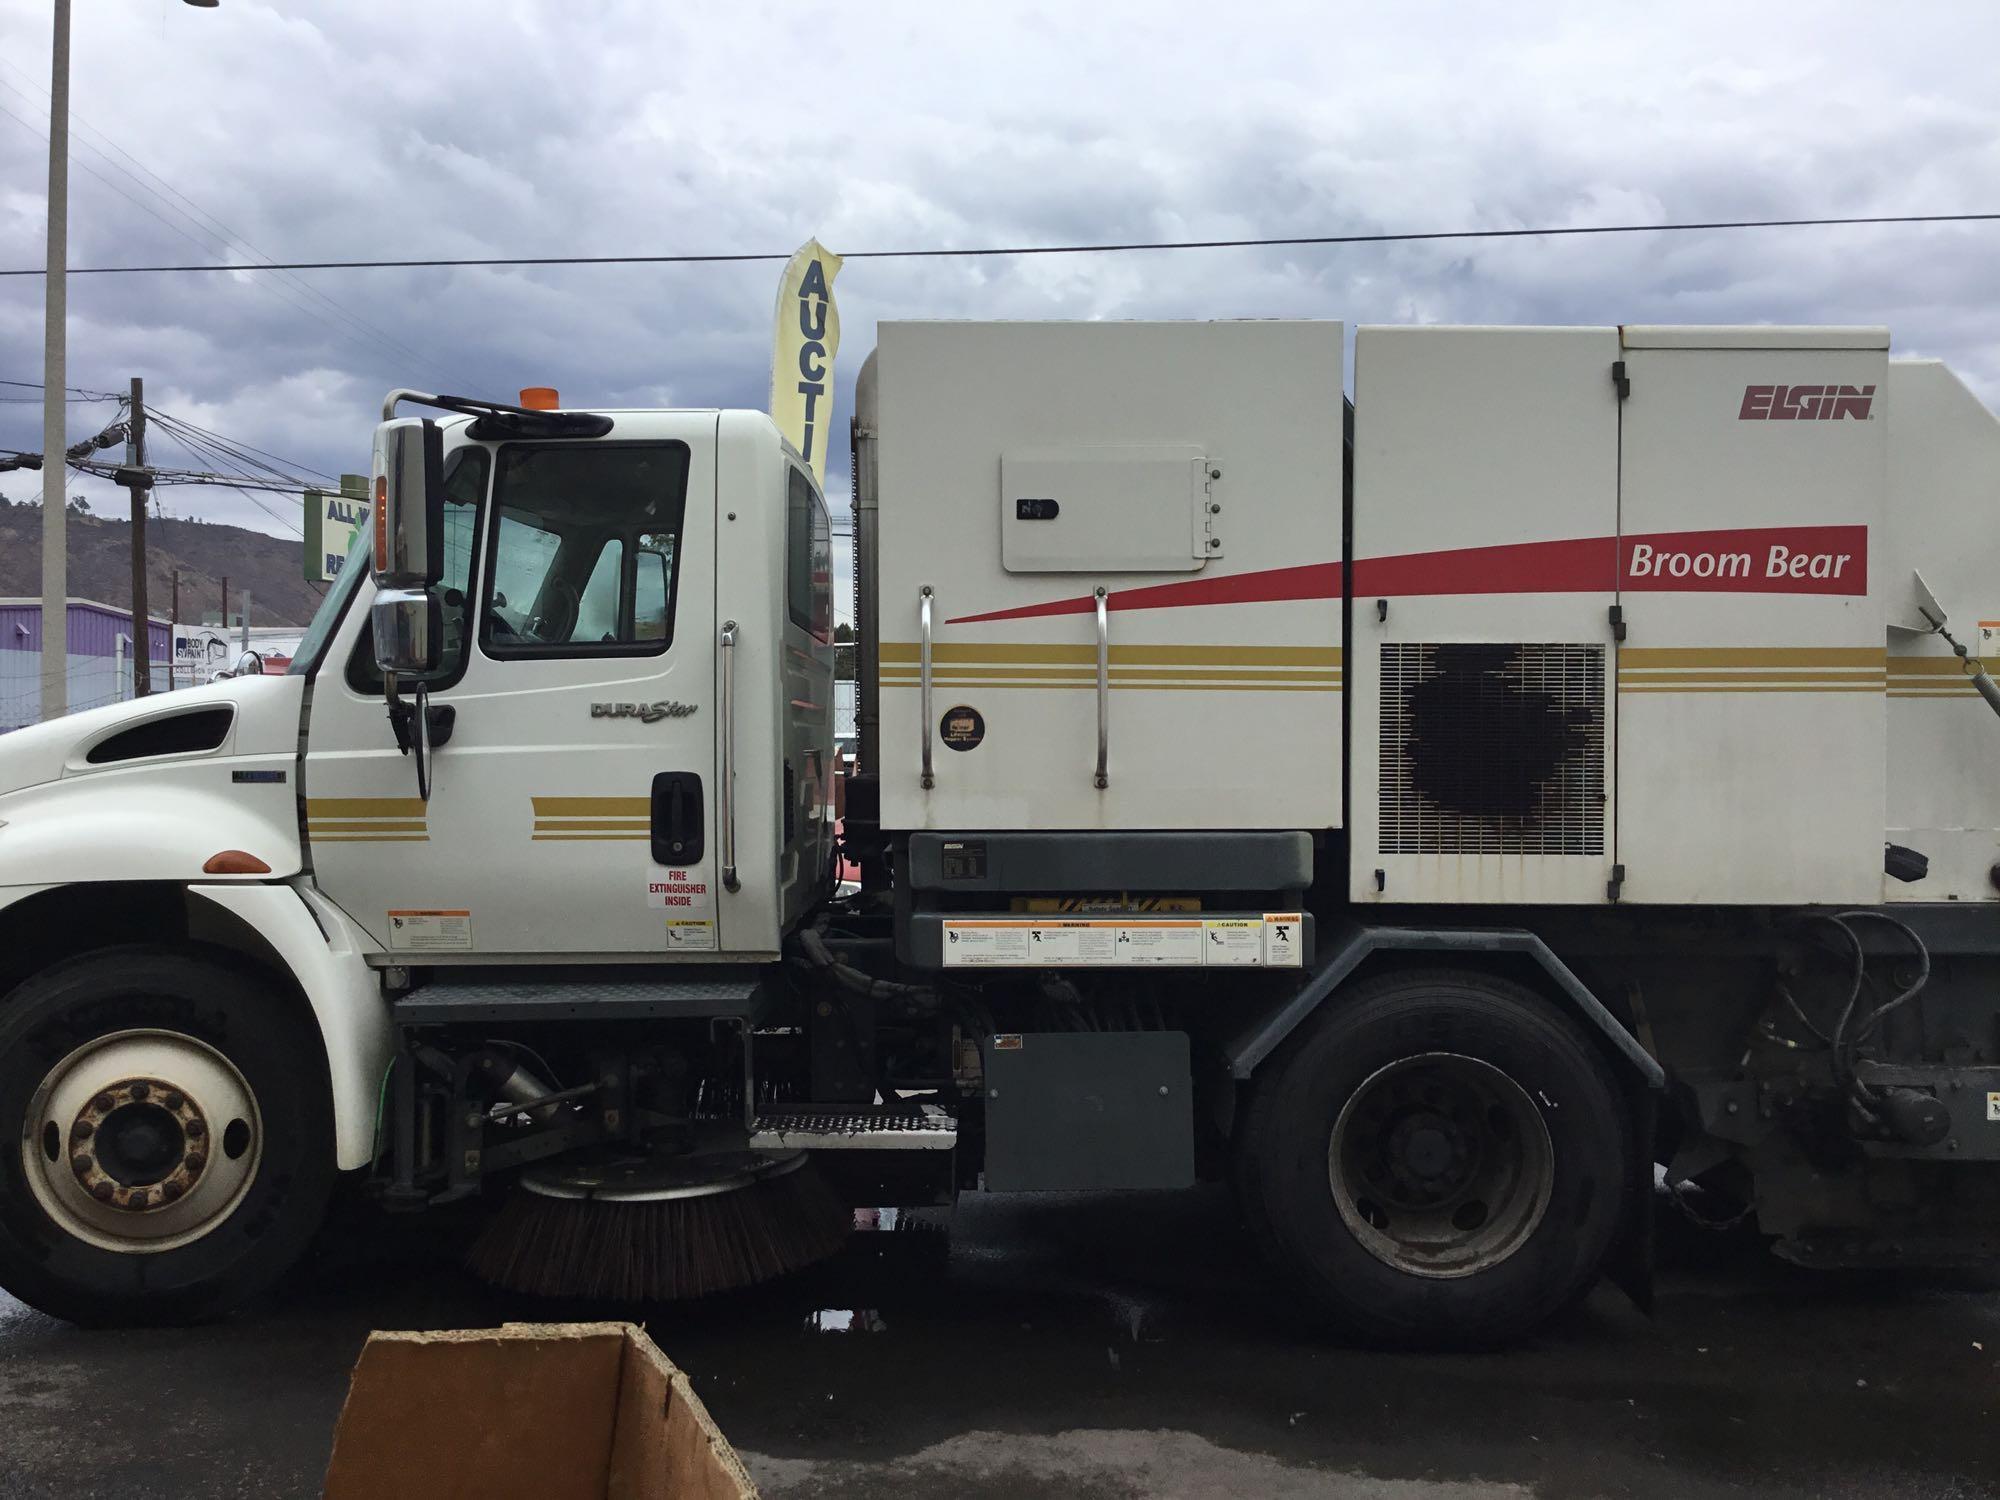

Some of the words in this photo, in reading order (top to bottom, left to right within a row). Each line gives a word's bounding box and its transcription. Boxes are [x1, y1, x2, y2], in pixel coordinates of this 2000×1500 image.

[798, 259, 829, 463] AUCTI
[1738, 385, 1876, 420] ELGIN
[327, 500, 356, 525] ALL
[1629, 544, 1751, 577] Broom
[1765, 545, 1851, 578] Bear
[187, 649, 205, 659] PAINT
[669, 870, 687, 881] FIRE
[649, 883, 706, 894] EXTINGUISHER
[665, 896, 692, 906] INSIDE
